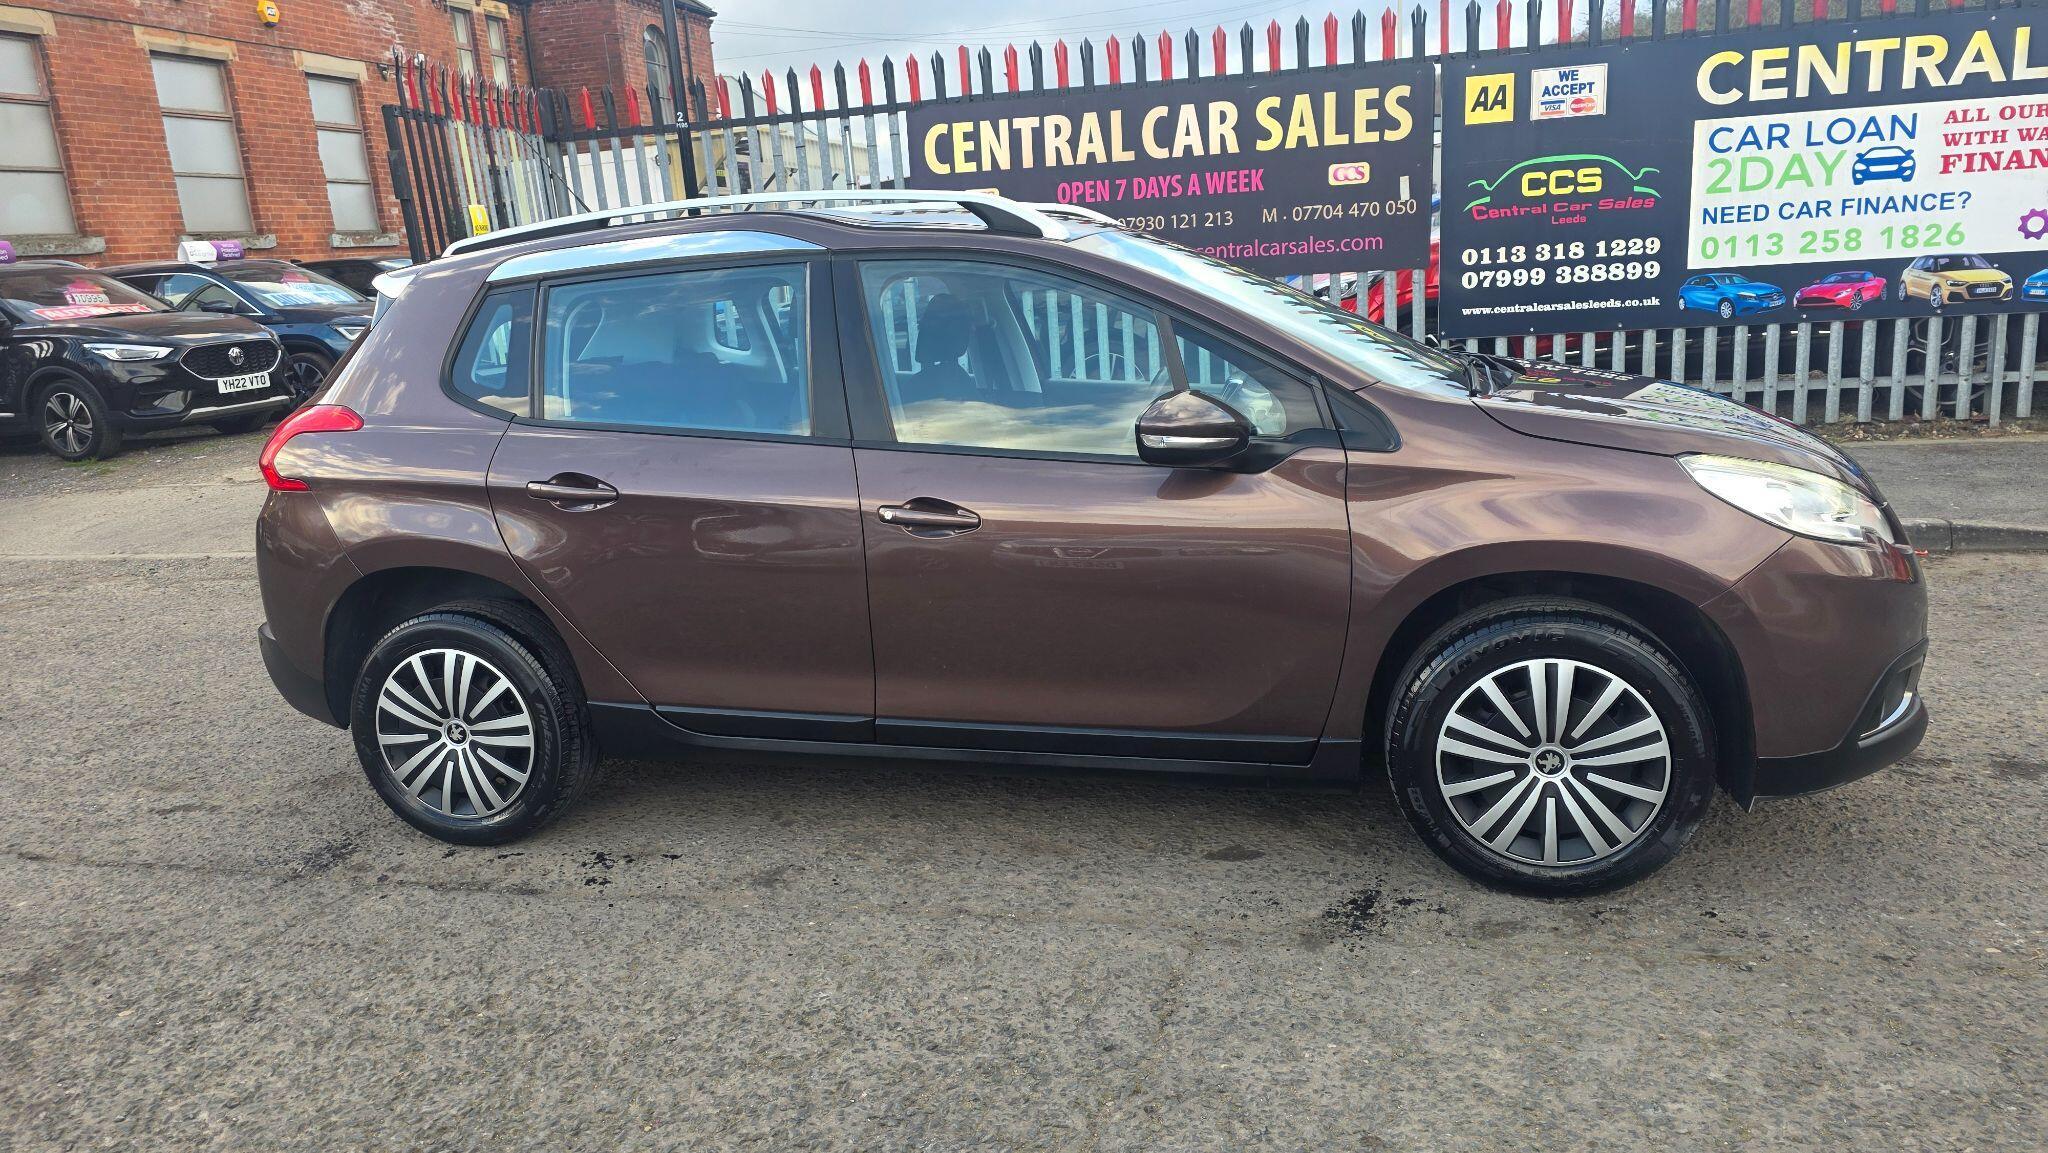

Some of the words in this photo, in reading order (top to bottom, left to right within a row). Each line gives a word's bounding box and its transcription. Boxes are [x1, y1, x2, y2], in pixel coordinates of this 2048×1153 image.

[1558, 69, 1579, 82] WE
[1697, 26, 2048, 105] CENTRAL
[1471, 84, 1506, 112] AA
[1541, 81, 1595, 97] ACCEPT
[676, 111, 684, 122] 2
[1544, 103, 1561, 112] VISA
[1943, 107, 1990, 125] ALL
[924, 109, 1135, 175] CENTRAL
[1141, 100, 1239, 160] CAR
[1255, 85, 1413, 152] SALES
[1708, 123, 1791, 153] CAR
[1805, 112, 1918, 147] LOAN
[1943, 128, 2009, 147] WITH
[1333, 165, 1366, 182] CCS
[1521, 167, 1603, 197] CCS
[1705, 149, 1848, 194] 2DAY
[1057, 177, 1109, 205] OPEN
[1115, 177, 1128, 200] 7
[1133, 173, 1182, 199] DAYS
[1187, 171, 1201, 196] A
[1205, 168, 1264, 195] WEEK
[1171, 213, 1197, 229] 121
[1204, 210, 1234, 227] 213
[1292, 204, 1344, 222] 07704
[1349, 201, 1380, 217] 470
[1385, 198, 1417, 215] 050
[1471, 203, 1547, 221] Central
[1553, 202, 1593, 213] Car
[1598, 196, 1655, 211] Sales
[1551, 214, 1587, 225] Leeds
[1702, 203, 1770, 225] NEED
[1778, 199, 1832, 220] CAR
[1841, 190, 1972, 217] FINANCE?
[1461, 245, 1527, 266] 0113
[1535, 241, 1585, 261] 318
[1595, 236, 1661, 258] 1229
[1701, 232, 1783, 260] 0113
[1799, 227, 1863, 255] 258
[1879, 221, 1966, 249] 1826
[1461, 267, 1546, 289] 07999
[1555, 260, 1661, 284] 388899
[1462, 296, 1661, 316] www.centralcarsalesleeds.co.uk
[222, 377, 248, 391] YH22
[248, 374, 266, 387] VTO
